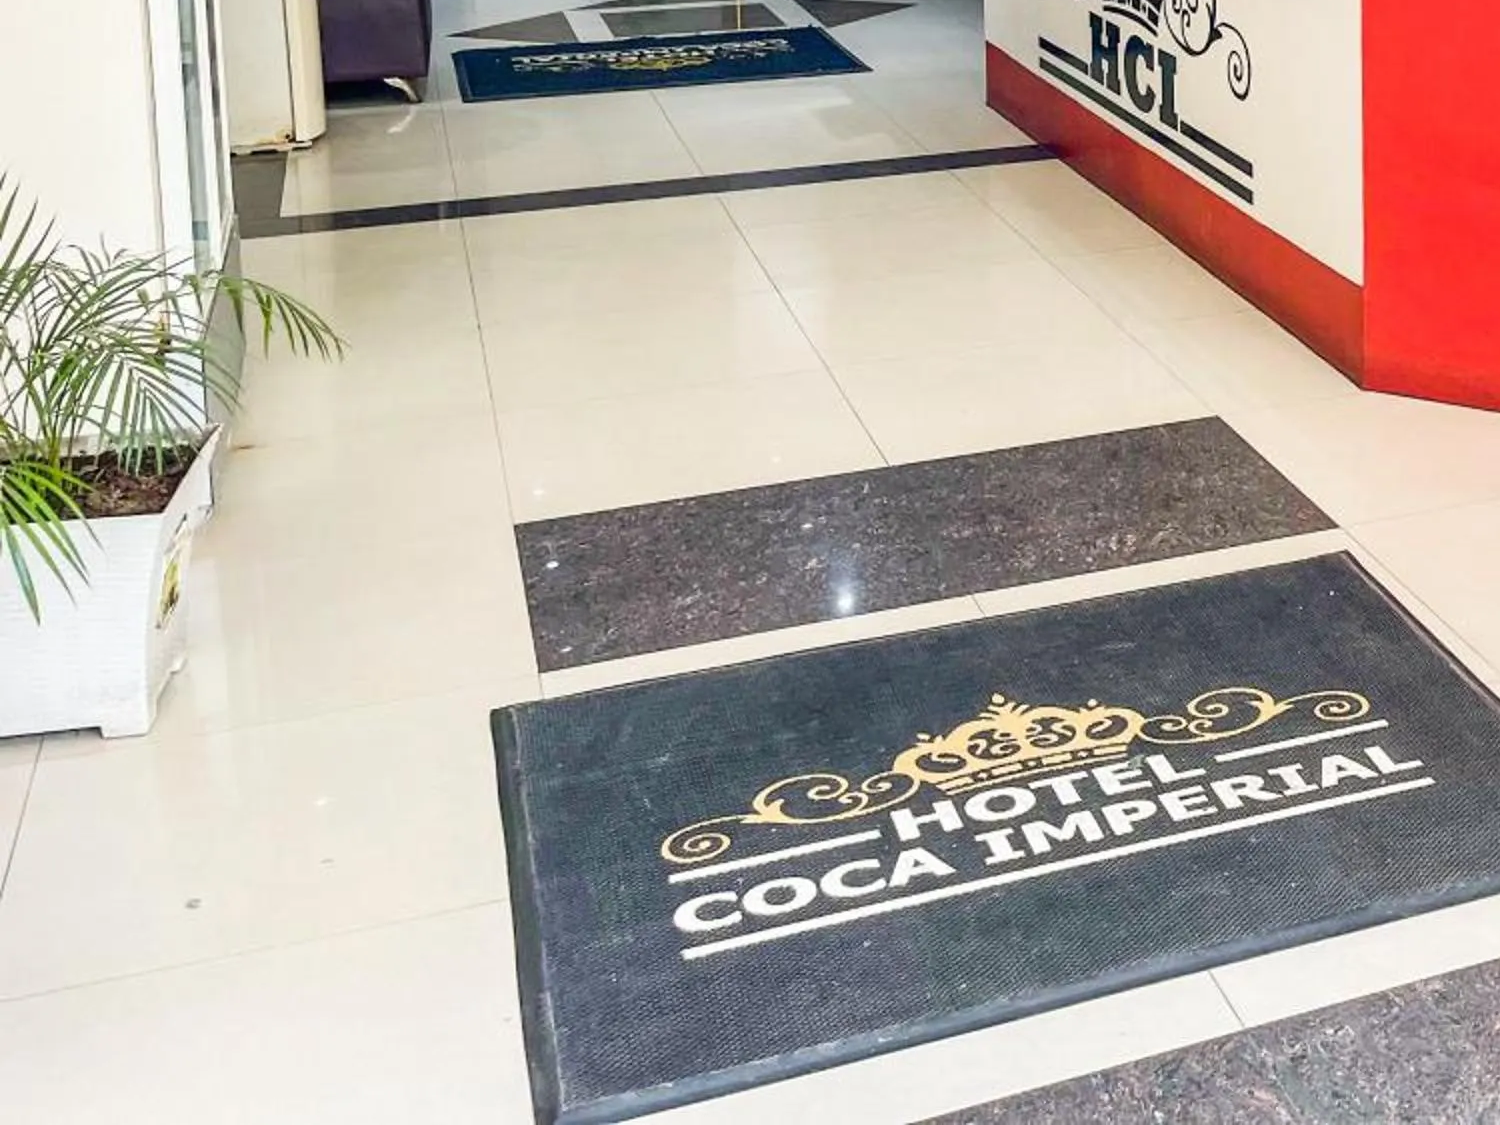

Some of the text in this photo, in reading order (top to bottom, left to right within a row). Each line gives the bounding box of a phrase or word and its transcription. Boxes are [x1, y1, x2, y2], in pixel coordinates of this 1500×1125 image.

[1088, 11, 1179, 132] HCI
[671, 743, 1424, 935] COCA IMPERIAL
[891, 753, 1206, 843] HOTEL
